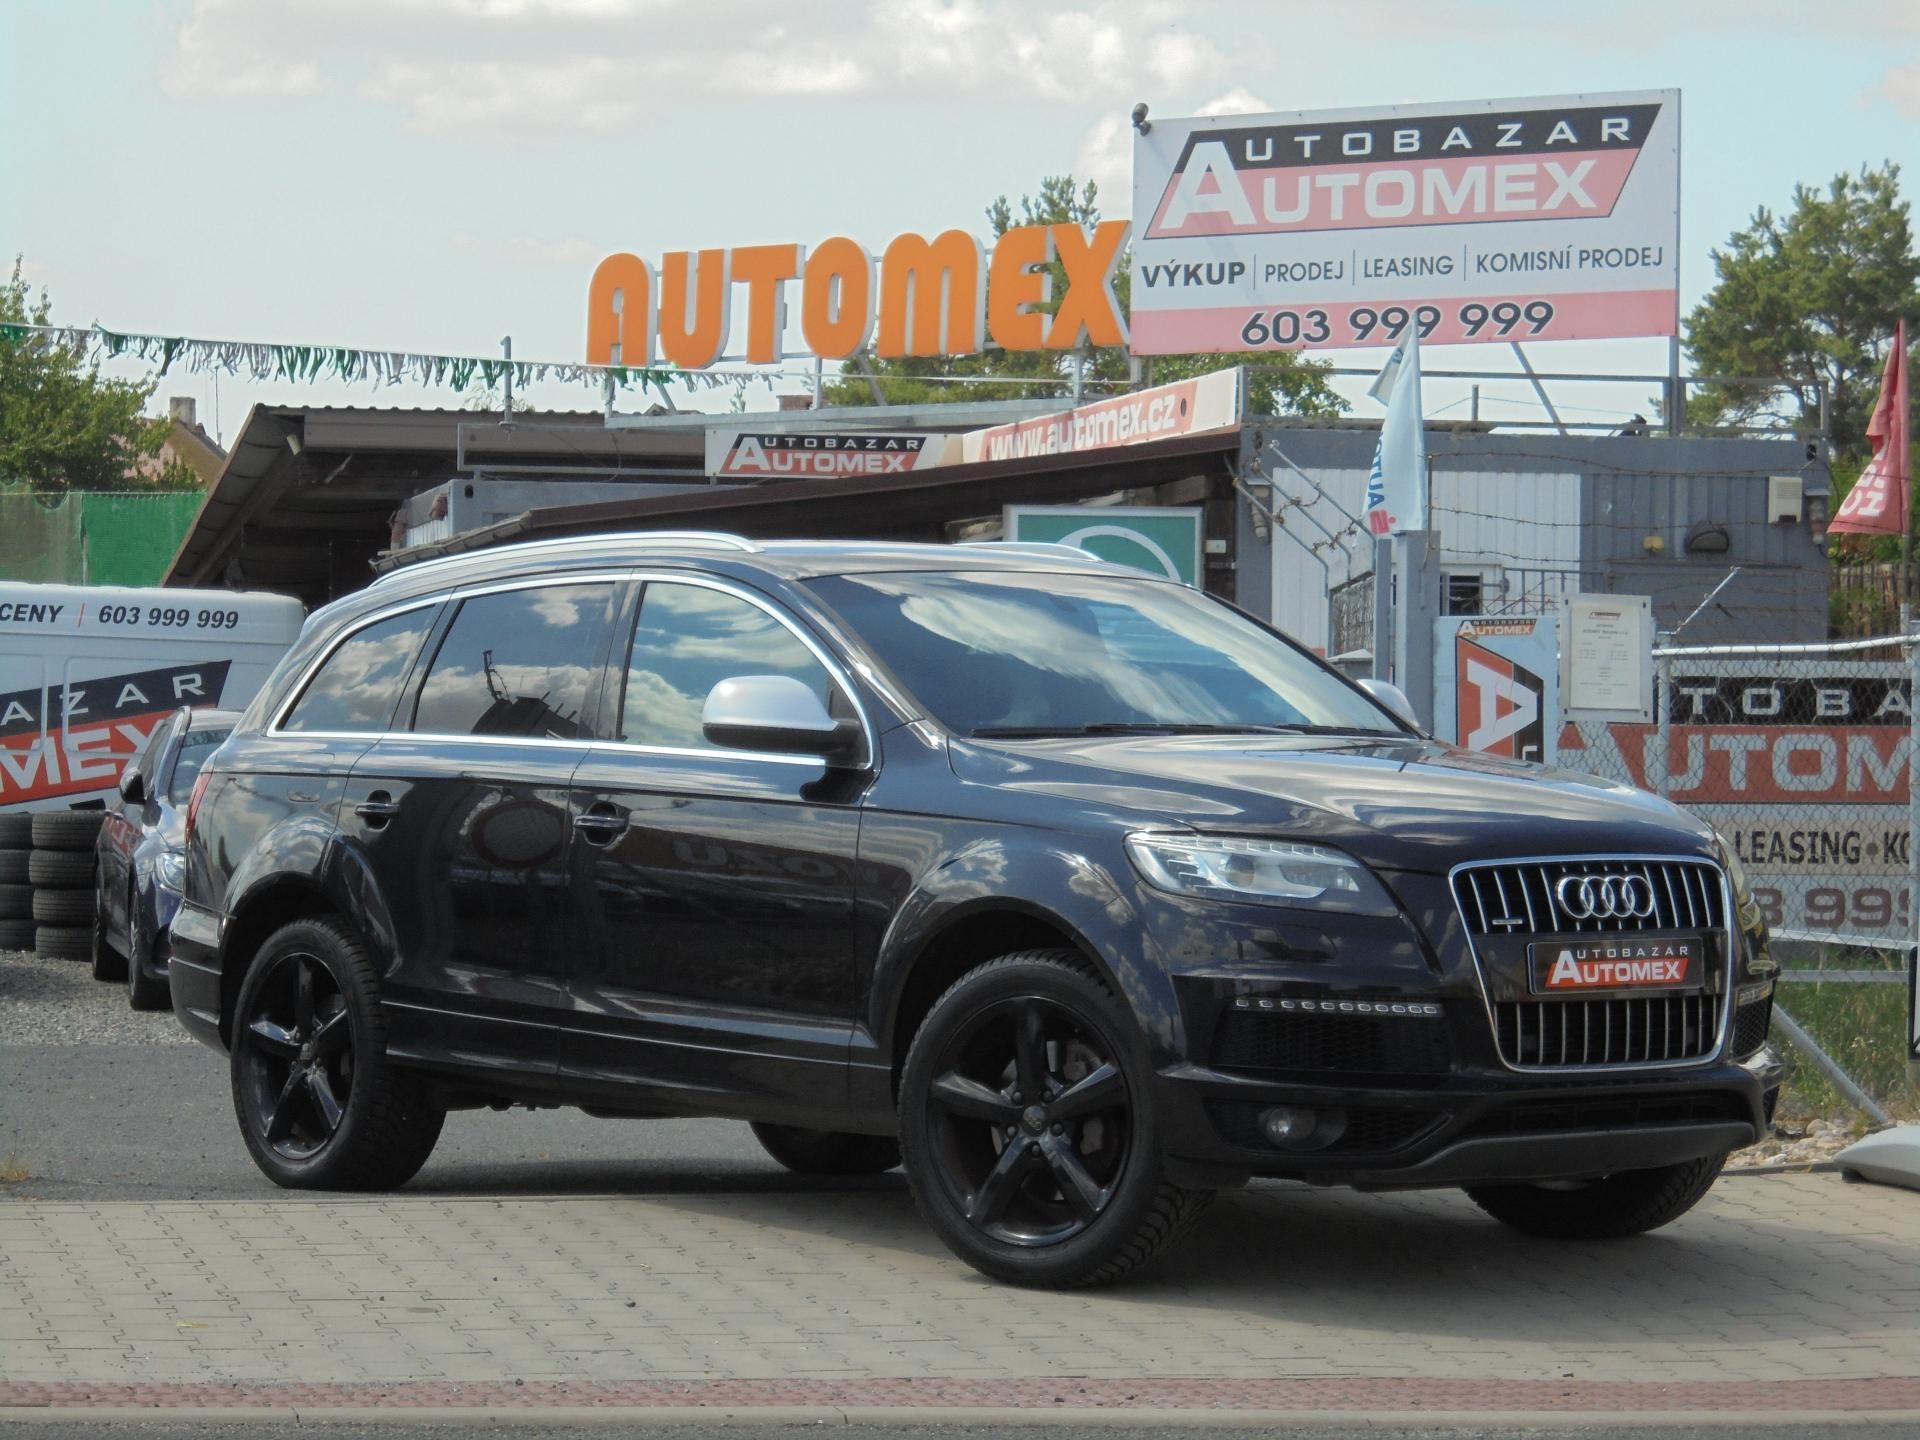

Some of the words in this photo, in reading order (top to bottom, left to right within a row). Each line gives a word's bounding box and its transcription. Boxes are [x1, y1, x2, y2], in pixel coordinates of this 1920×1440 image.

[1158, 140, 1598, 230] AUTOMEX
[1141, 258, 1245, 288] VÝKUP
[1264, 261, 1344, 283] PRODEJ
[1362, 255, 1454, 279] LEASING
[1476, 245, 1572, 274] KOMISNÍ
[1578, 246, 1662, 268] PRODEJ
[587, 220, 1131, 369] AUTOMEX
[1241, 311, 1331, 346] 603
[1348, 305, 1442, 342] 999
[1458, 301, 1554, 336] 999
[991, 394, 1176, 460] www.automex.cz
[729, 437, 905, 473] AUTOMEX
[0, 603, 64, 623] CENY
[99, 605, 140, 625] 603
[147, 607, 190, 628] 999
[196, 610, 239, 630] 999
[1458, 621, 1531, 636] AUTOMEX
[1734, 830, 1861, 865] LEASING
[1550, 950, 1681, 985] AUTOMEX
